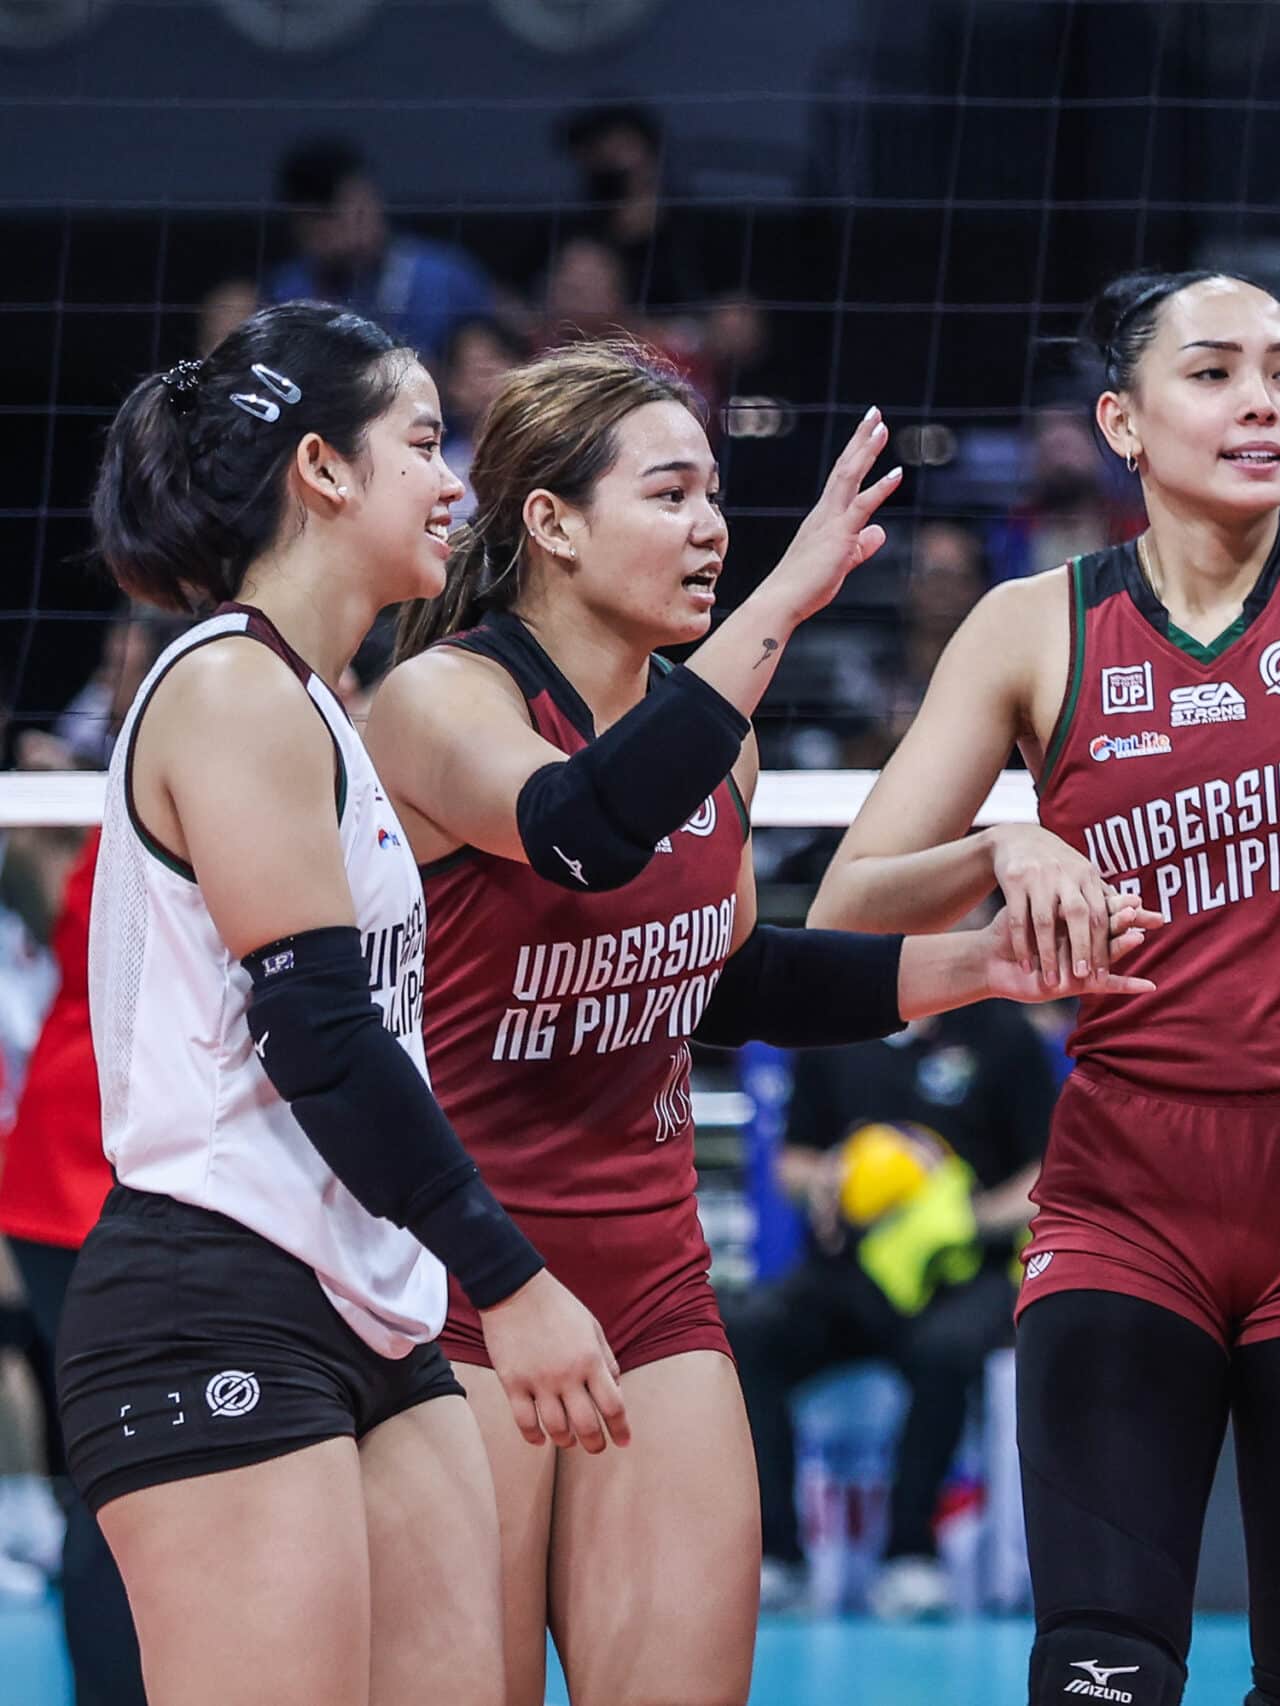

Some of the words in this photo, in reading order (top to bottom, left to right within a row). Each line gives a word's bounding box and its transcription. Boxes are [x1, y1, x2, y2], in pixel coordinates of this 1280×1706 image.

[1110, 686, 1145, 705] UP
[1171, 704, 1246, 722] STRONG
[1115, 732, 1170, 752] InLife
[492, 1003, 562, 1061] NG
[1063, 1679, 1133, 1704] MIZUNO
